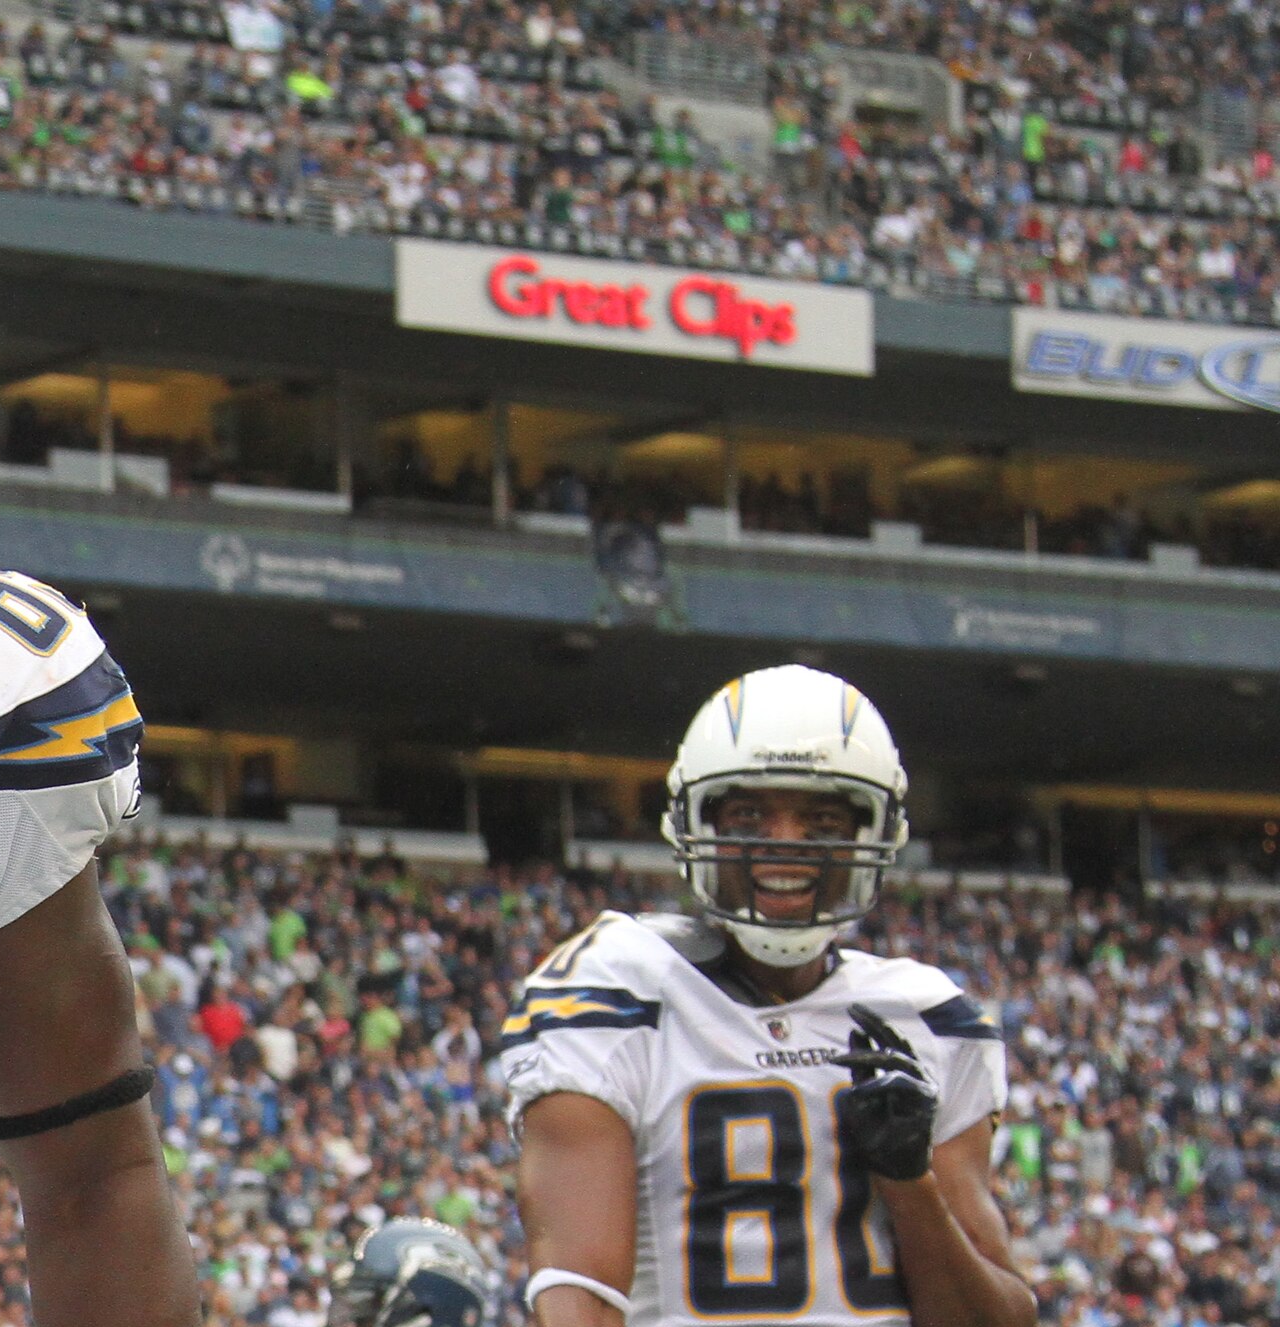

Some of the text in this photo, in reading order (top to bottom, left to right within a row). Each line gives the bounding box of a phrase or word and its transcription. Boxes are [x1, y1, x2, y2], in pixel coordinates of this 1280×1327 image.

[488, 254, 797, 359] Great Clips
[1026, 328, 1196, 389] BUD
